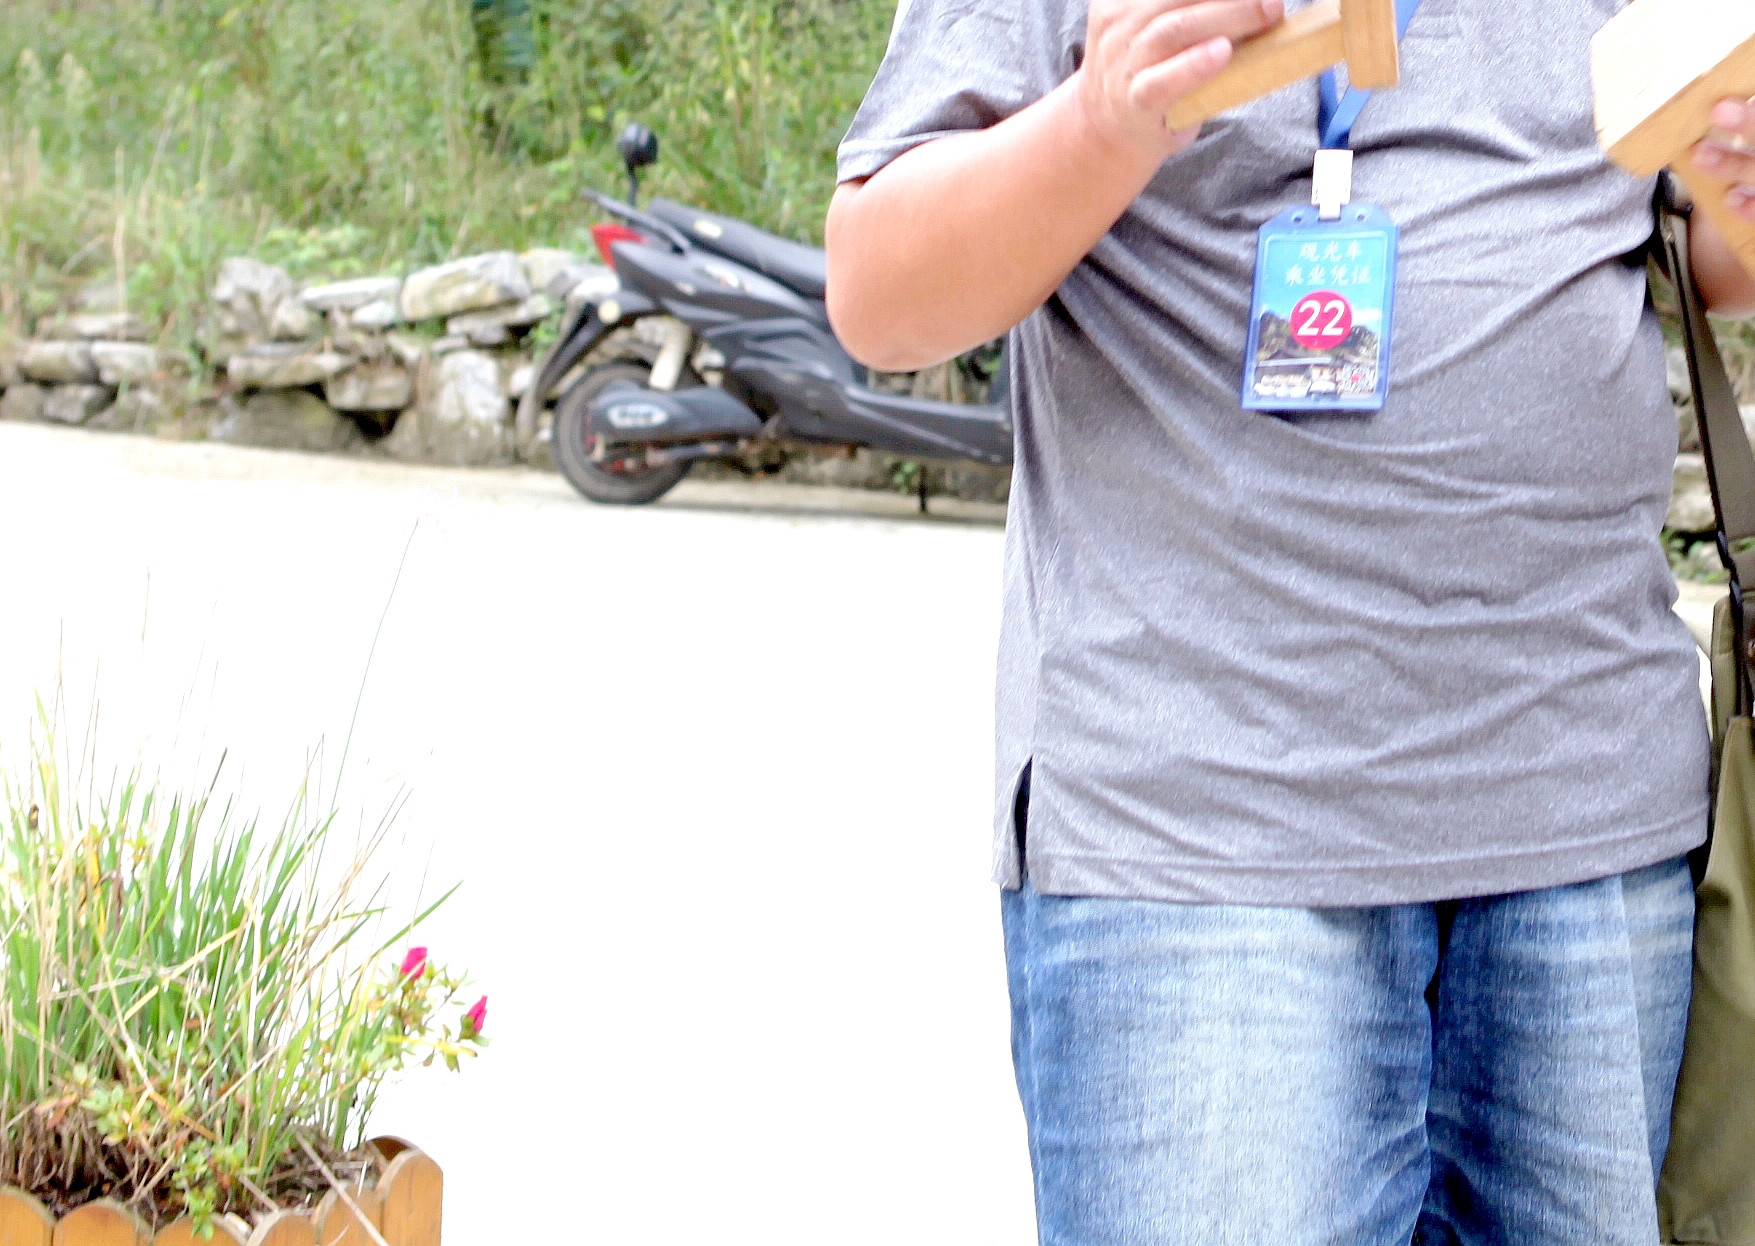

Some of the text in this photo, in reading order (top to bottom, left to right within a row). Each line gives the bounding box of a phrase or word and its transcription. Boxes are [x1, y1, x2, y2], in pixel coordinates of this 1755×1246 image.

[1299, 240, 1363, 261] 观光车
[1285, 264, 1371, 286] 乘坐凭证
[1297, 299, 1345, 337] 22
